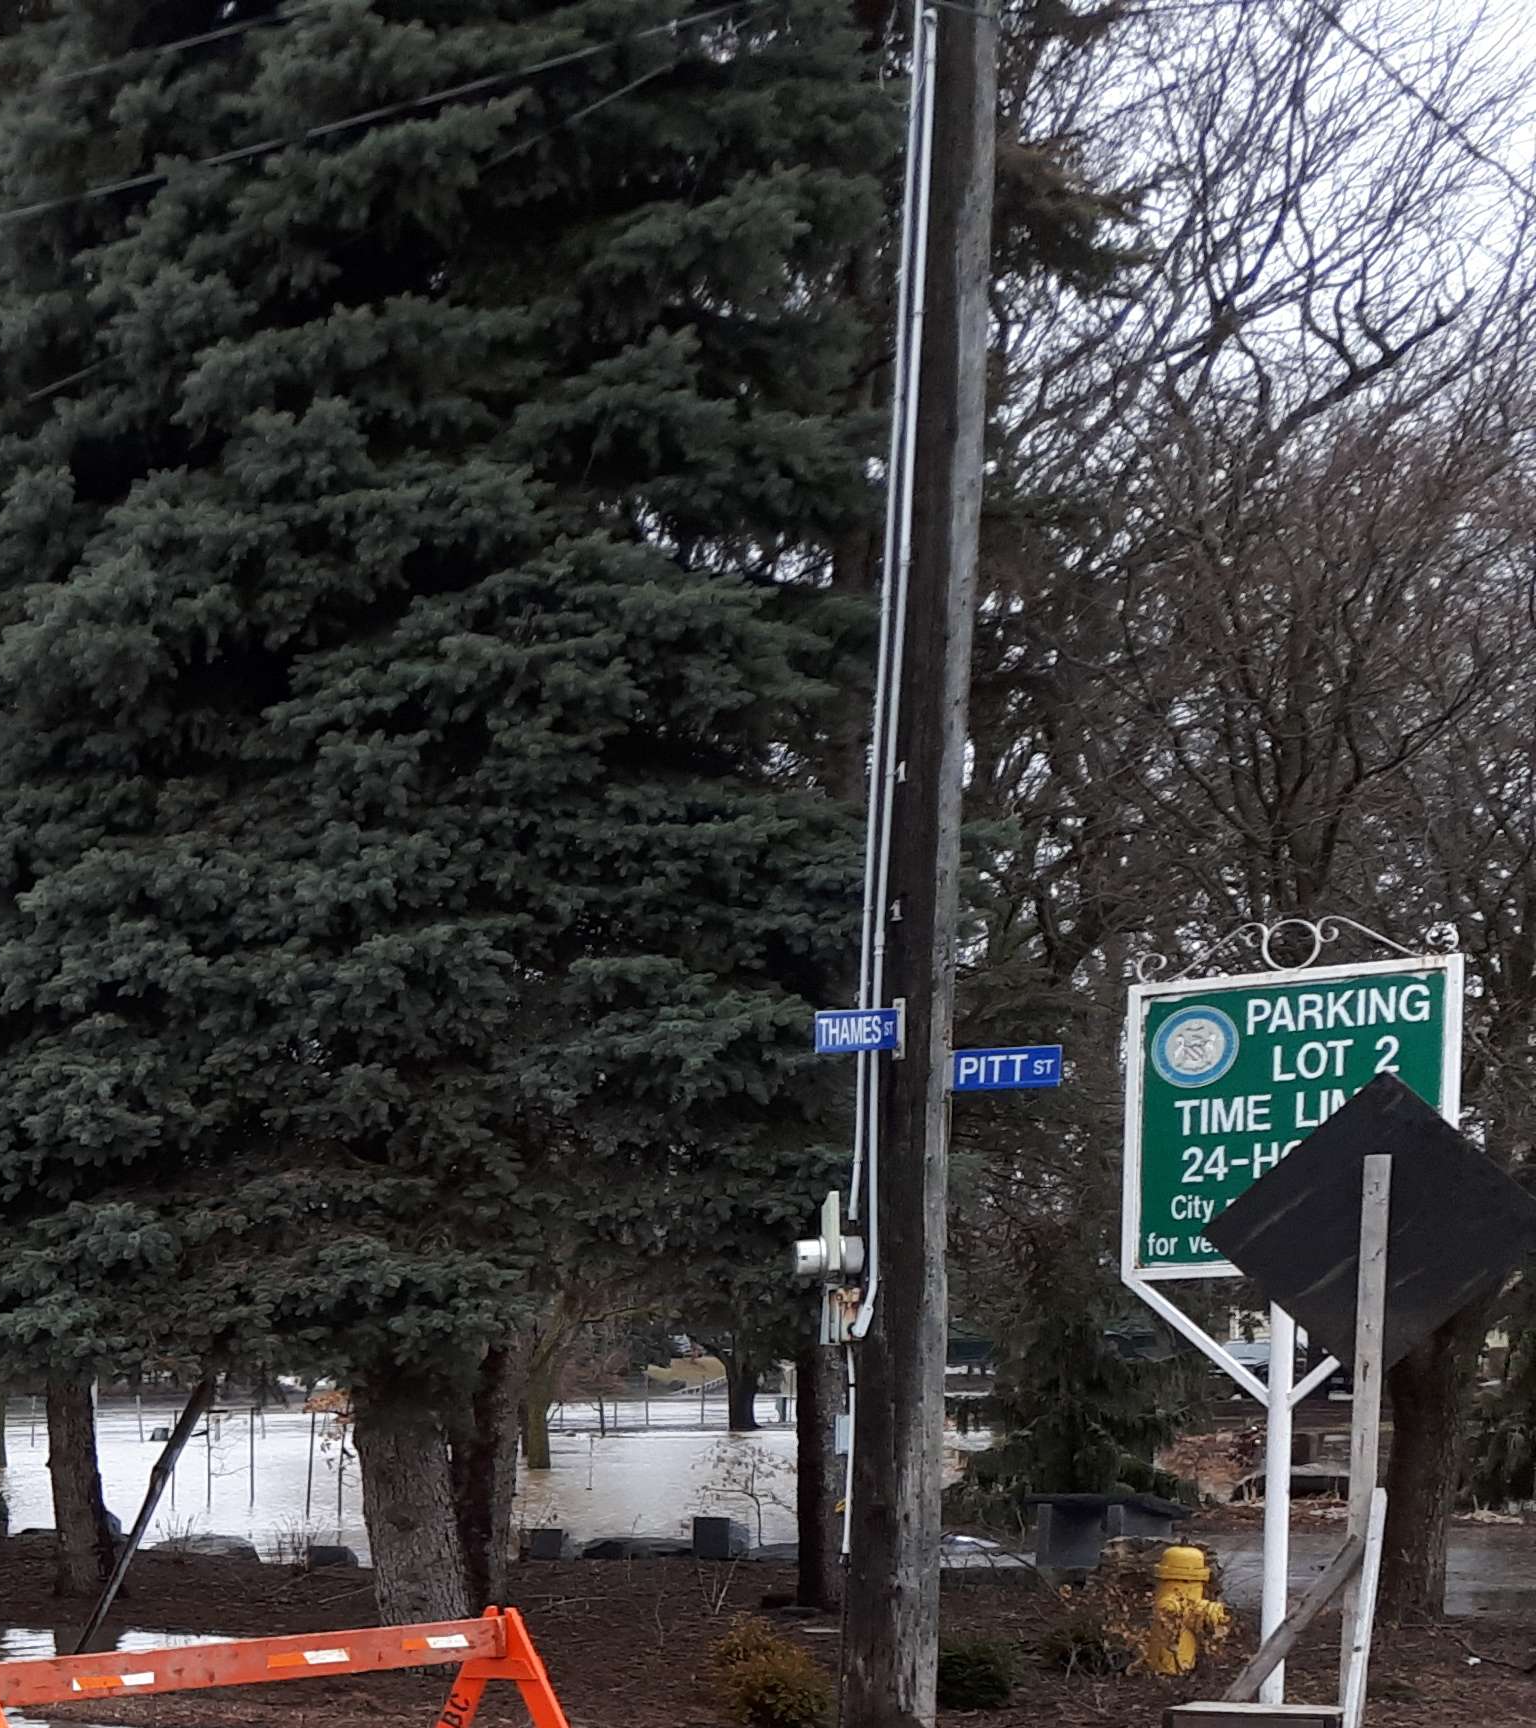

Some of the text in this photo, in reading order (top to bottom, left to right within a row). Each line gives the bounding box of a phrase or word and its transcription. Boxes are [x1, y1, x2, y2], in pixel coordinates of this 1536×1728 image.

[1246, 984, 1430, 1035] PARKING
[818, 1014, 895, 1047] THAMES ST
[959, 1053, 1056, 1085] PITT ST
[1272, 1035, 1401, 1083] LOT 2
[1174, 1093, 1273, 1137] TIME
[1170, 1194, 1215, 1224] City
[1147, 1232, 1178, 1257] for
